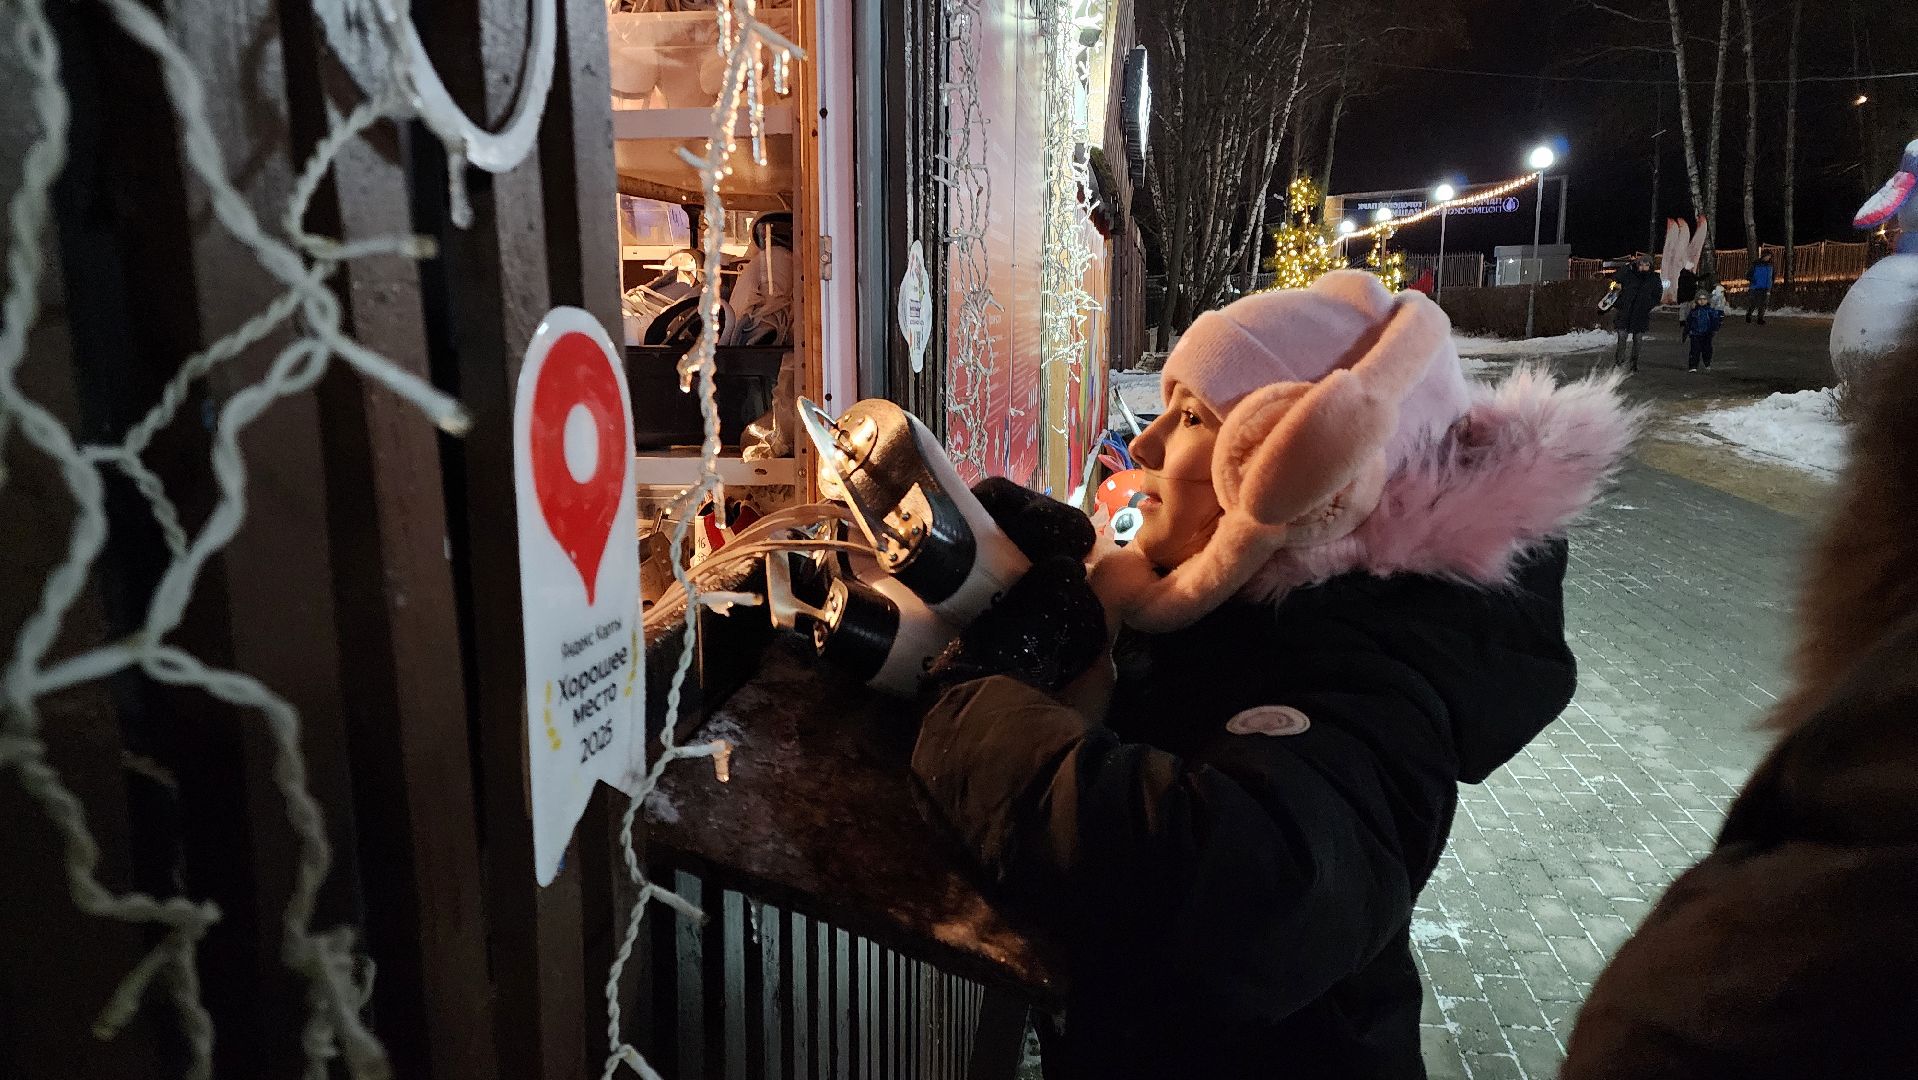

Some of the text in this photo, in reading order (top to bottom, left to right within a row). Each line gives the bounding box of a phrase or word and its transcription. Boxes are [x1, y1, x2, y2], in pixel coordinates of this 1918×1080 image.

[558, 646, 628, 704] Хорошее
[573, 682, 617, 727] место
[580, 718, 613, 763] 2025
